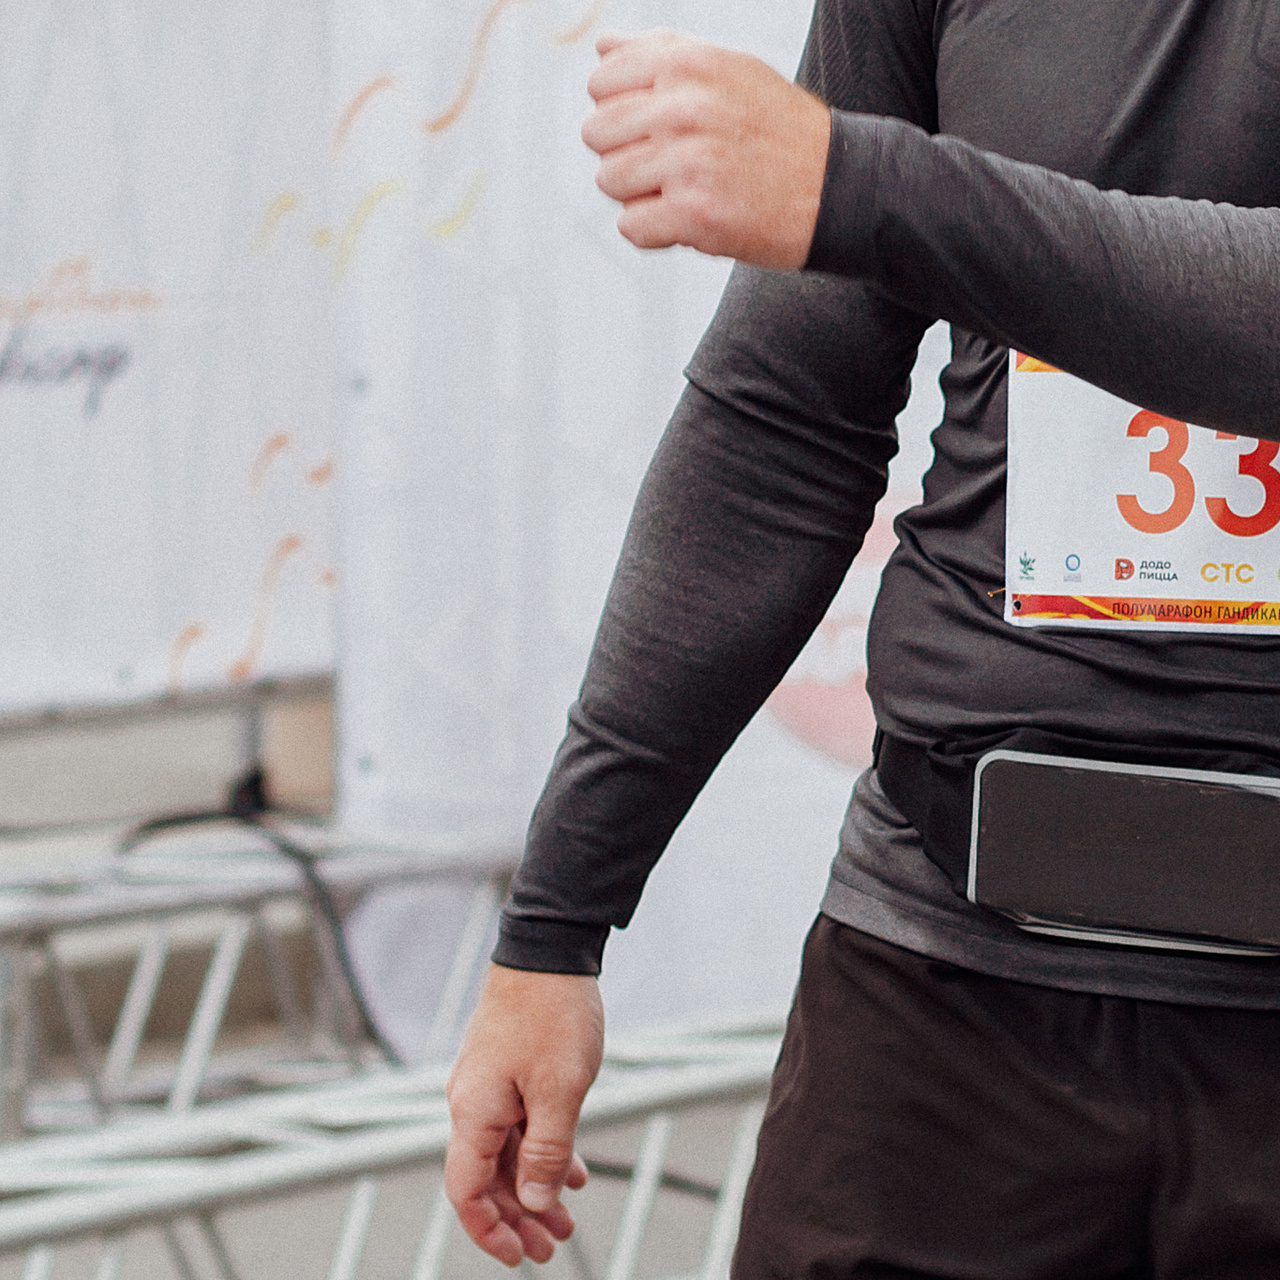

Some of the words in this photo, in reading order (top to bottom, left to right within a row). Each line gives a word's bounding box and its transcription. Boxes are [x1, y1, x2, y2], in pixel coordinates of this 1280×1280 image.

[1140, 561, 1171, 570] ДОДО
[1139, 572, 1178, 581] ПИЦЦА
[1201, 562, 1255, 583] СТС
[1112, 602, 1213, 618] ПОЛУМАРАФОН
